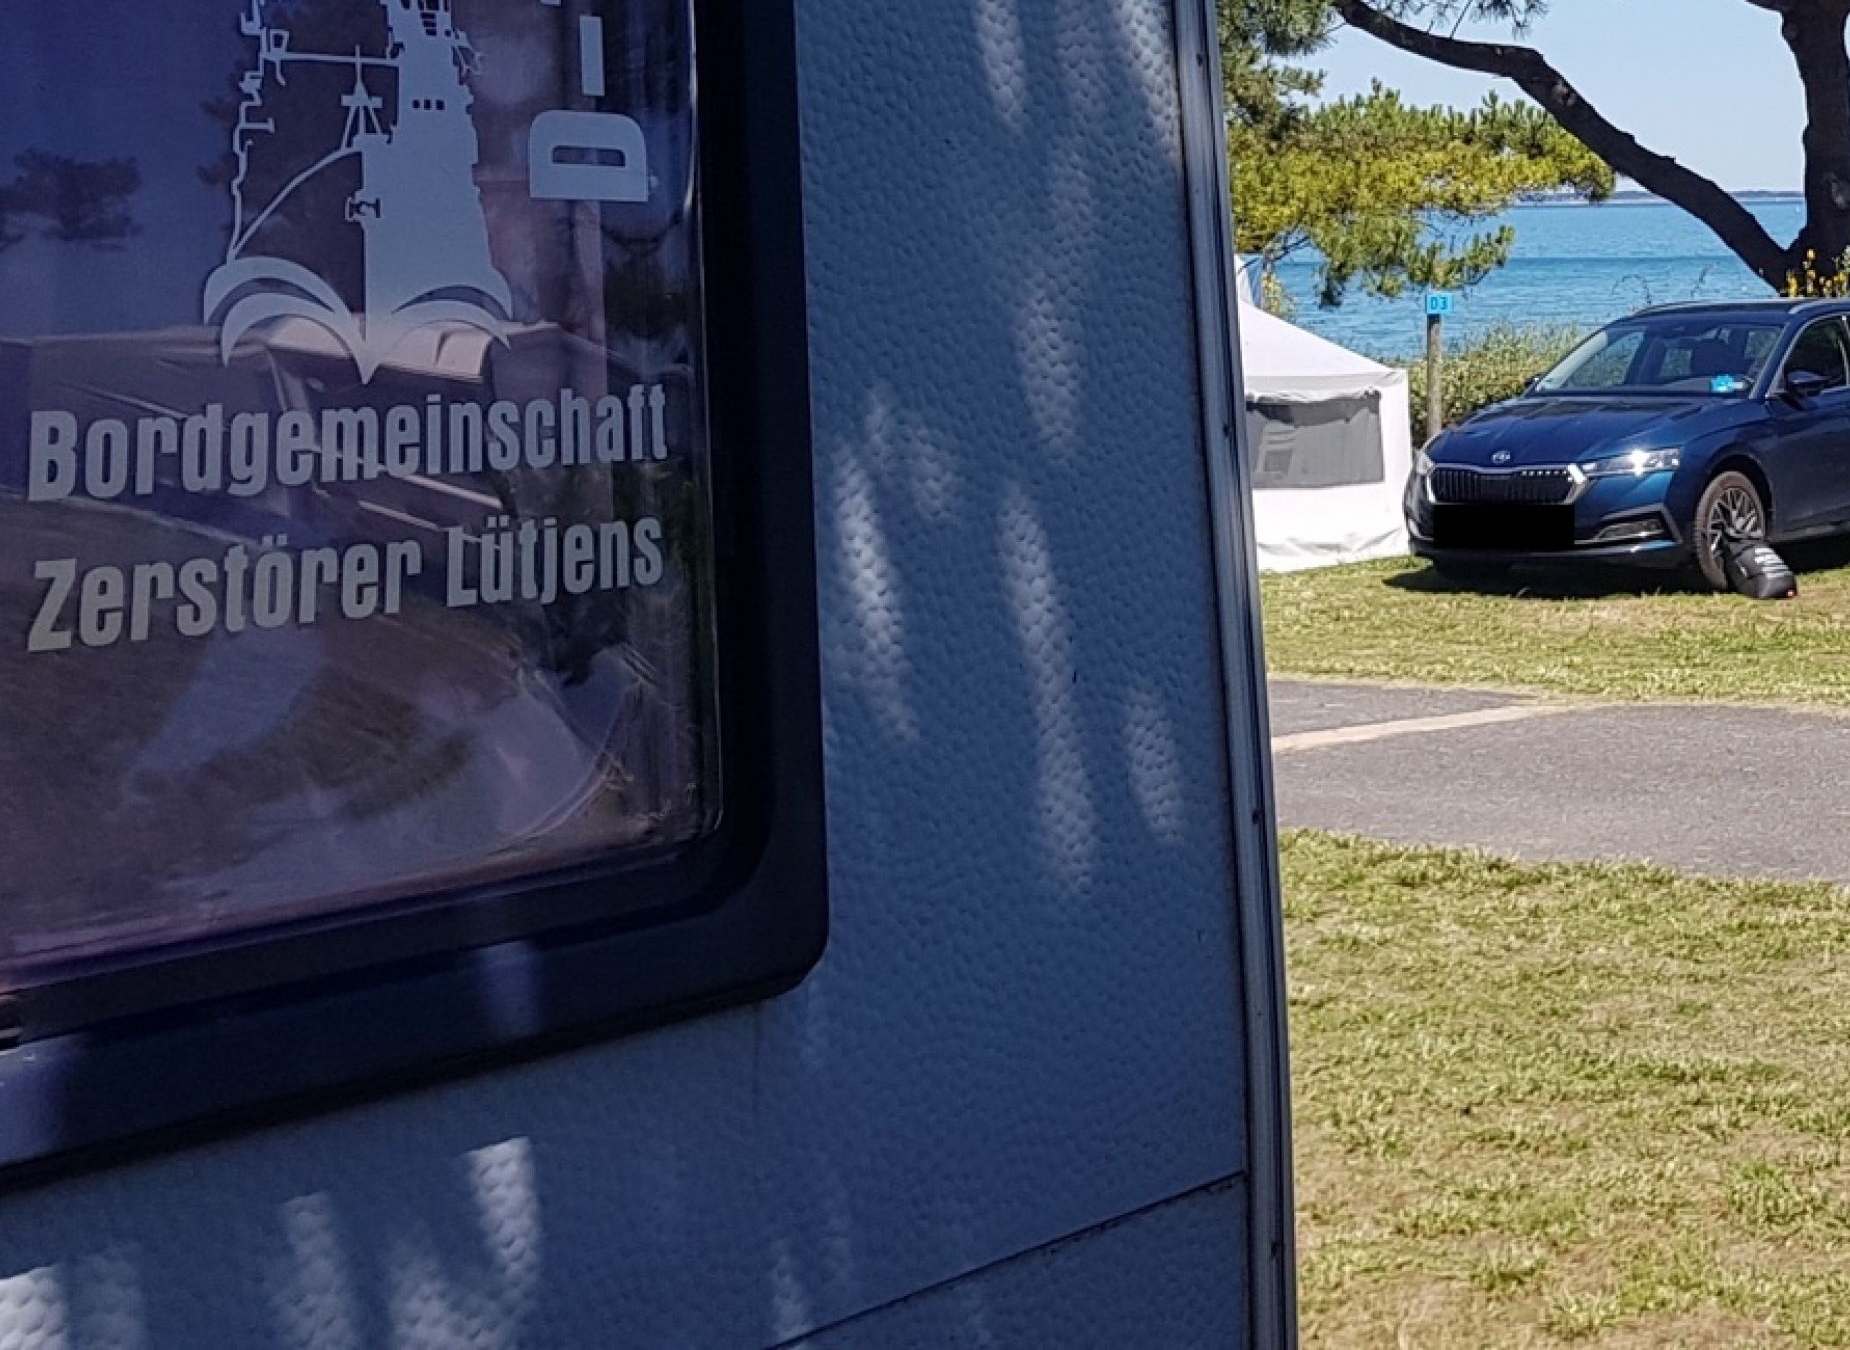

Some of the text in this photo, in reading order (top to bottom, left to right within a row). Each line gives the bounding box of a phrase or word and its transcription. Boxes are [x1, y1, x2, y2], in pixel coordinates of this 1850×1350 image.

[28, 383, 668, 502] Bordgemeinschaft
[28, 516, 663, 651] Zerstörer Lütjens
